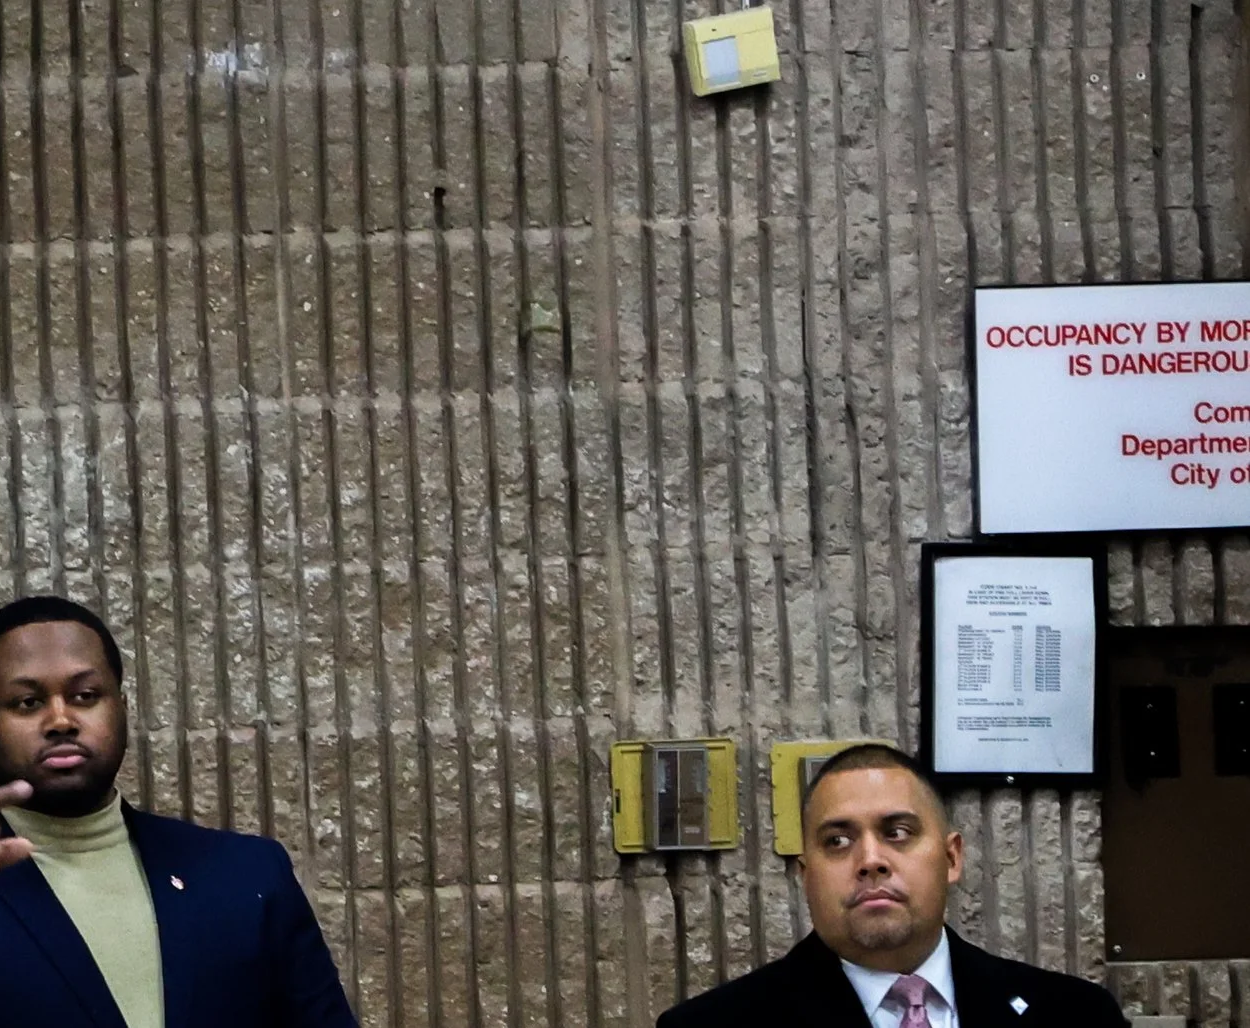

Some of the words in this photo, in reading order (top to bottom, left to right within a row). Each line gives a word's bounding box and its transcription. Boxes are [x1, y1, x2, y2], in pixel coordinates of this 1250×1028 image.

[986, 322, 1147, 348] OCCUPANCY
[1157, 321, 1190, 344] BY
[1069, 354, 1092, 376] IS
[1102, 350, 1249, 376] DANGEROU
[1121, 432, 1250, 460] Departme
[1170, 463, 1221, 489] City
[1230, 463, 1250, 484] o
